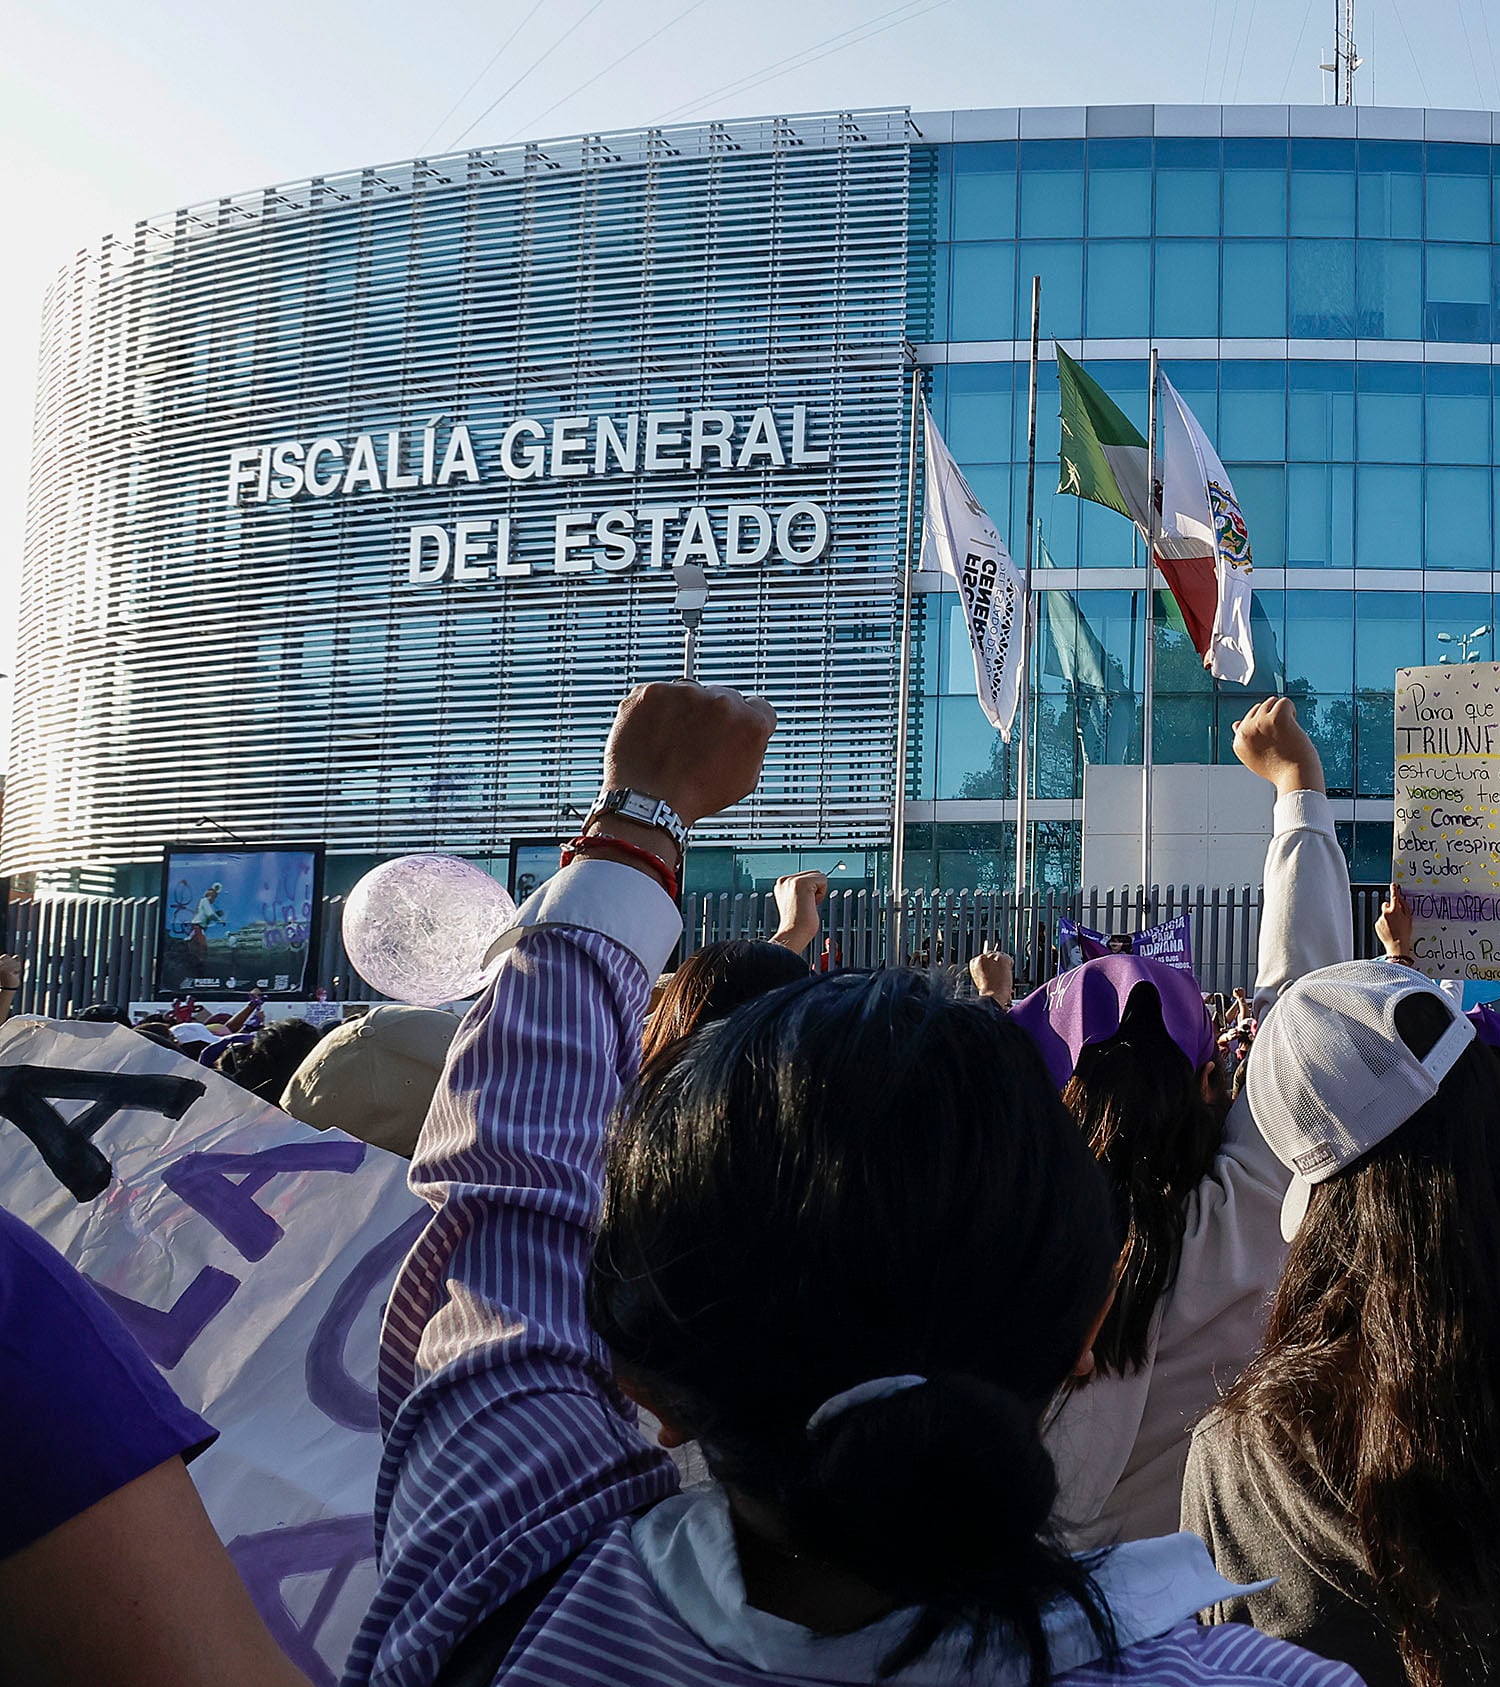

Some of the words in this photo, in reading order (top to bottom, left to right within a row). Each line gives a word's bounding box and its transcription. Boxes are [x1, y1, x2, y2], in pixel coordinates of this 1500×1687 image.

[227, 416, 480, 506] FISCALÍA
[501, 406, 831, 481] GENERAL
[410, 518, 532, 584] DEL
[554, 501, 830, 573] ESTADO
[1406, 683, 1454, 722] Para
[1465, 702, 1494, 724] que
[1398, 762, 1490, 781] estructura
[1396, 808, 1421, 824] que
[1409, 861, 1417, 876] y
[1140, 916, 1185, 938] JUSTICIA
[1152, 930, 1174, 943] PARA
[1140, 939, 1184, 957] ADRIANA
